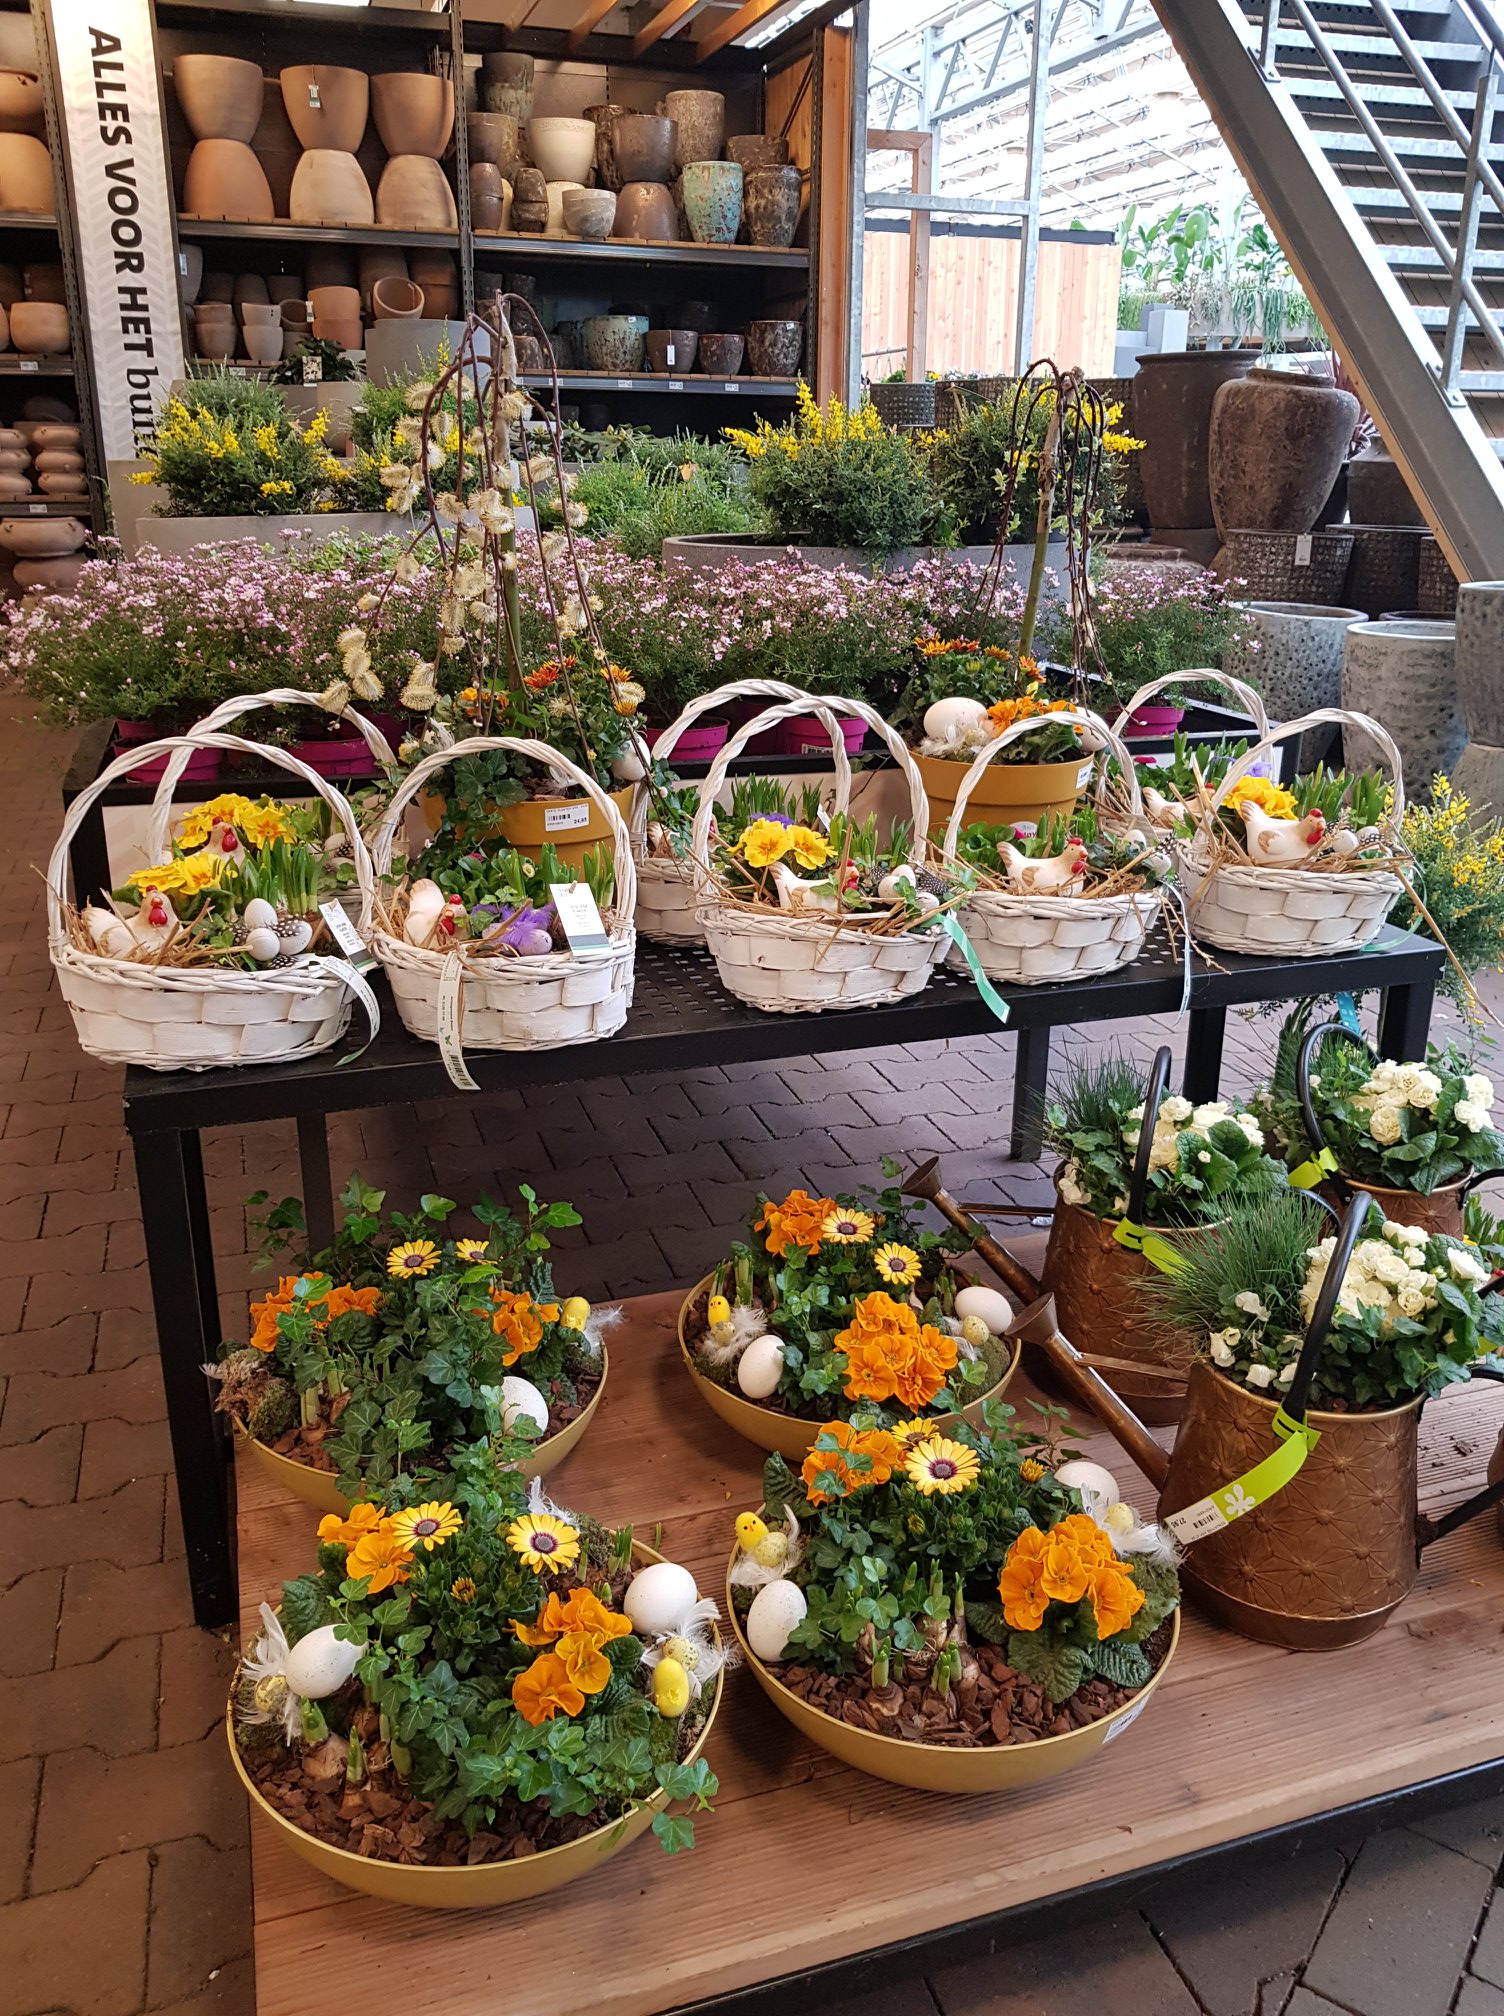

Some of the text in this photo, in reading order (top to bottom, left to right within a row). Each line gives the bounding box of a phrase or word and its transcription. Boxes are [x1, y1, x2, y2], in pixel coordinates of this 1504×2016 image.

[88, 26, 133, 146] ALLES
[104, 158, 145, 275] VOOR
[117, 286, 155, 358] HET
[573, 817, 588, 825] 24,95
[1170, 1517, 1187, 1529] 27,95
